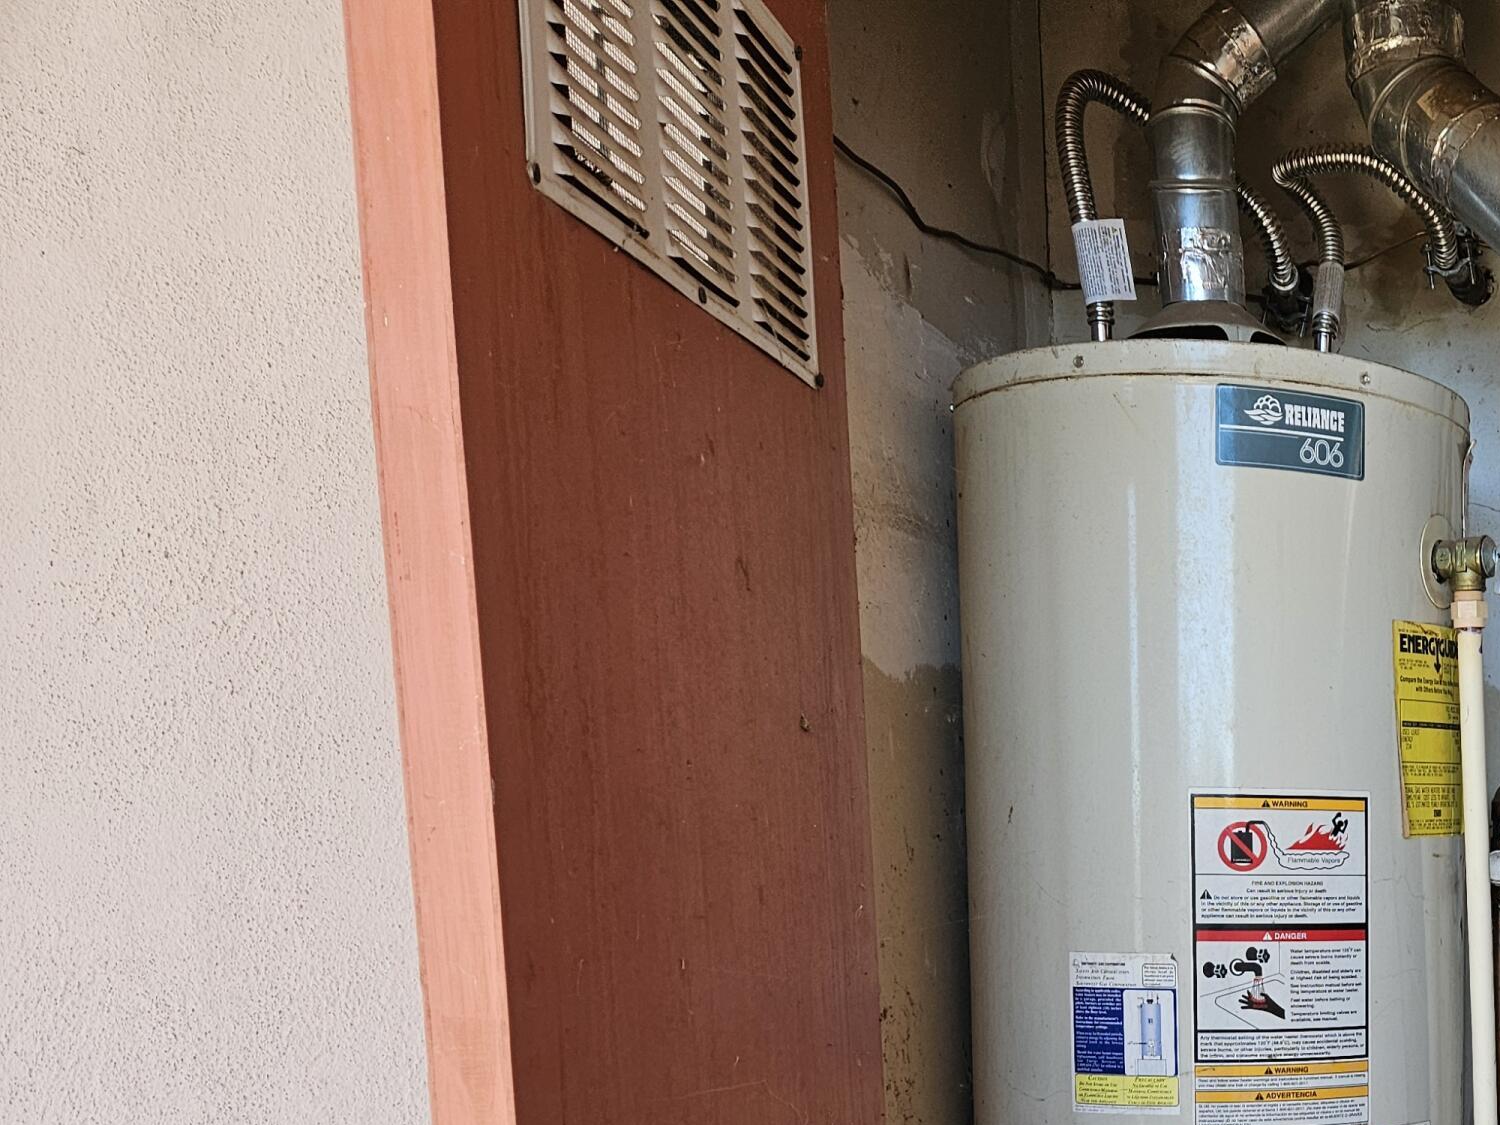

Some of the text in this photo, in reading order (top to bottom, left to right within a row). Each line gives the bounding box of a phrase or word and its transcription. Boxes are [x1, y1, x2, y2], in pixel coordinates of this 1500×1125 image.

[1284, 403, 1345, 433] RELIANCE
[1299, 438, 1344, 468] 606
[1272, 800, 1308, 808] WARNING
[1287, 856, 1341, 865] Flammable Vapors
[1274, 932, 1308, 940] DANGER
[1274, 1066, 1309, 1074] WARNING
[1265, 1090, 1318, 1100] ADVERTENCIA
